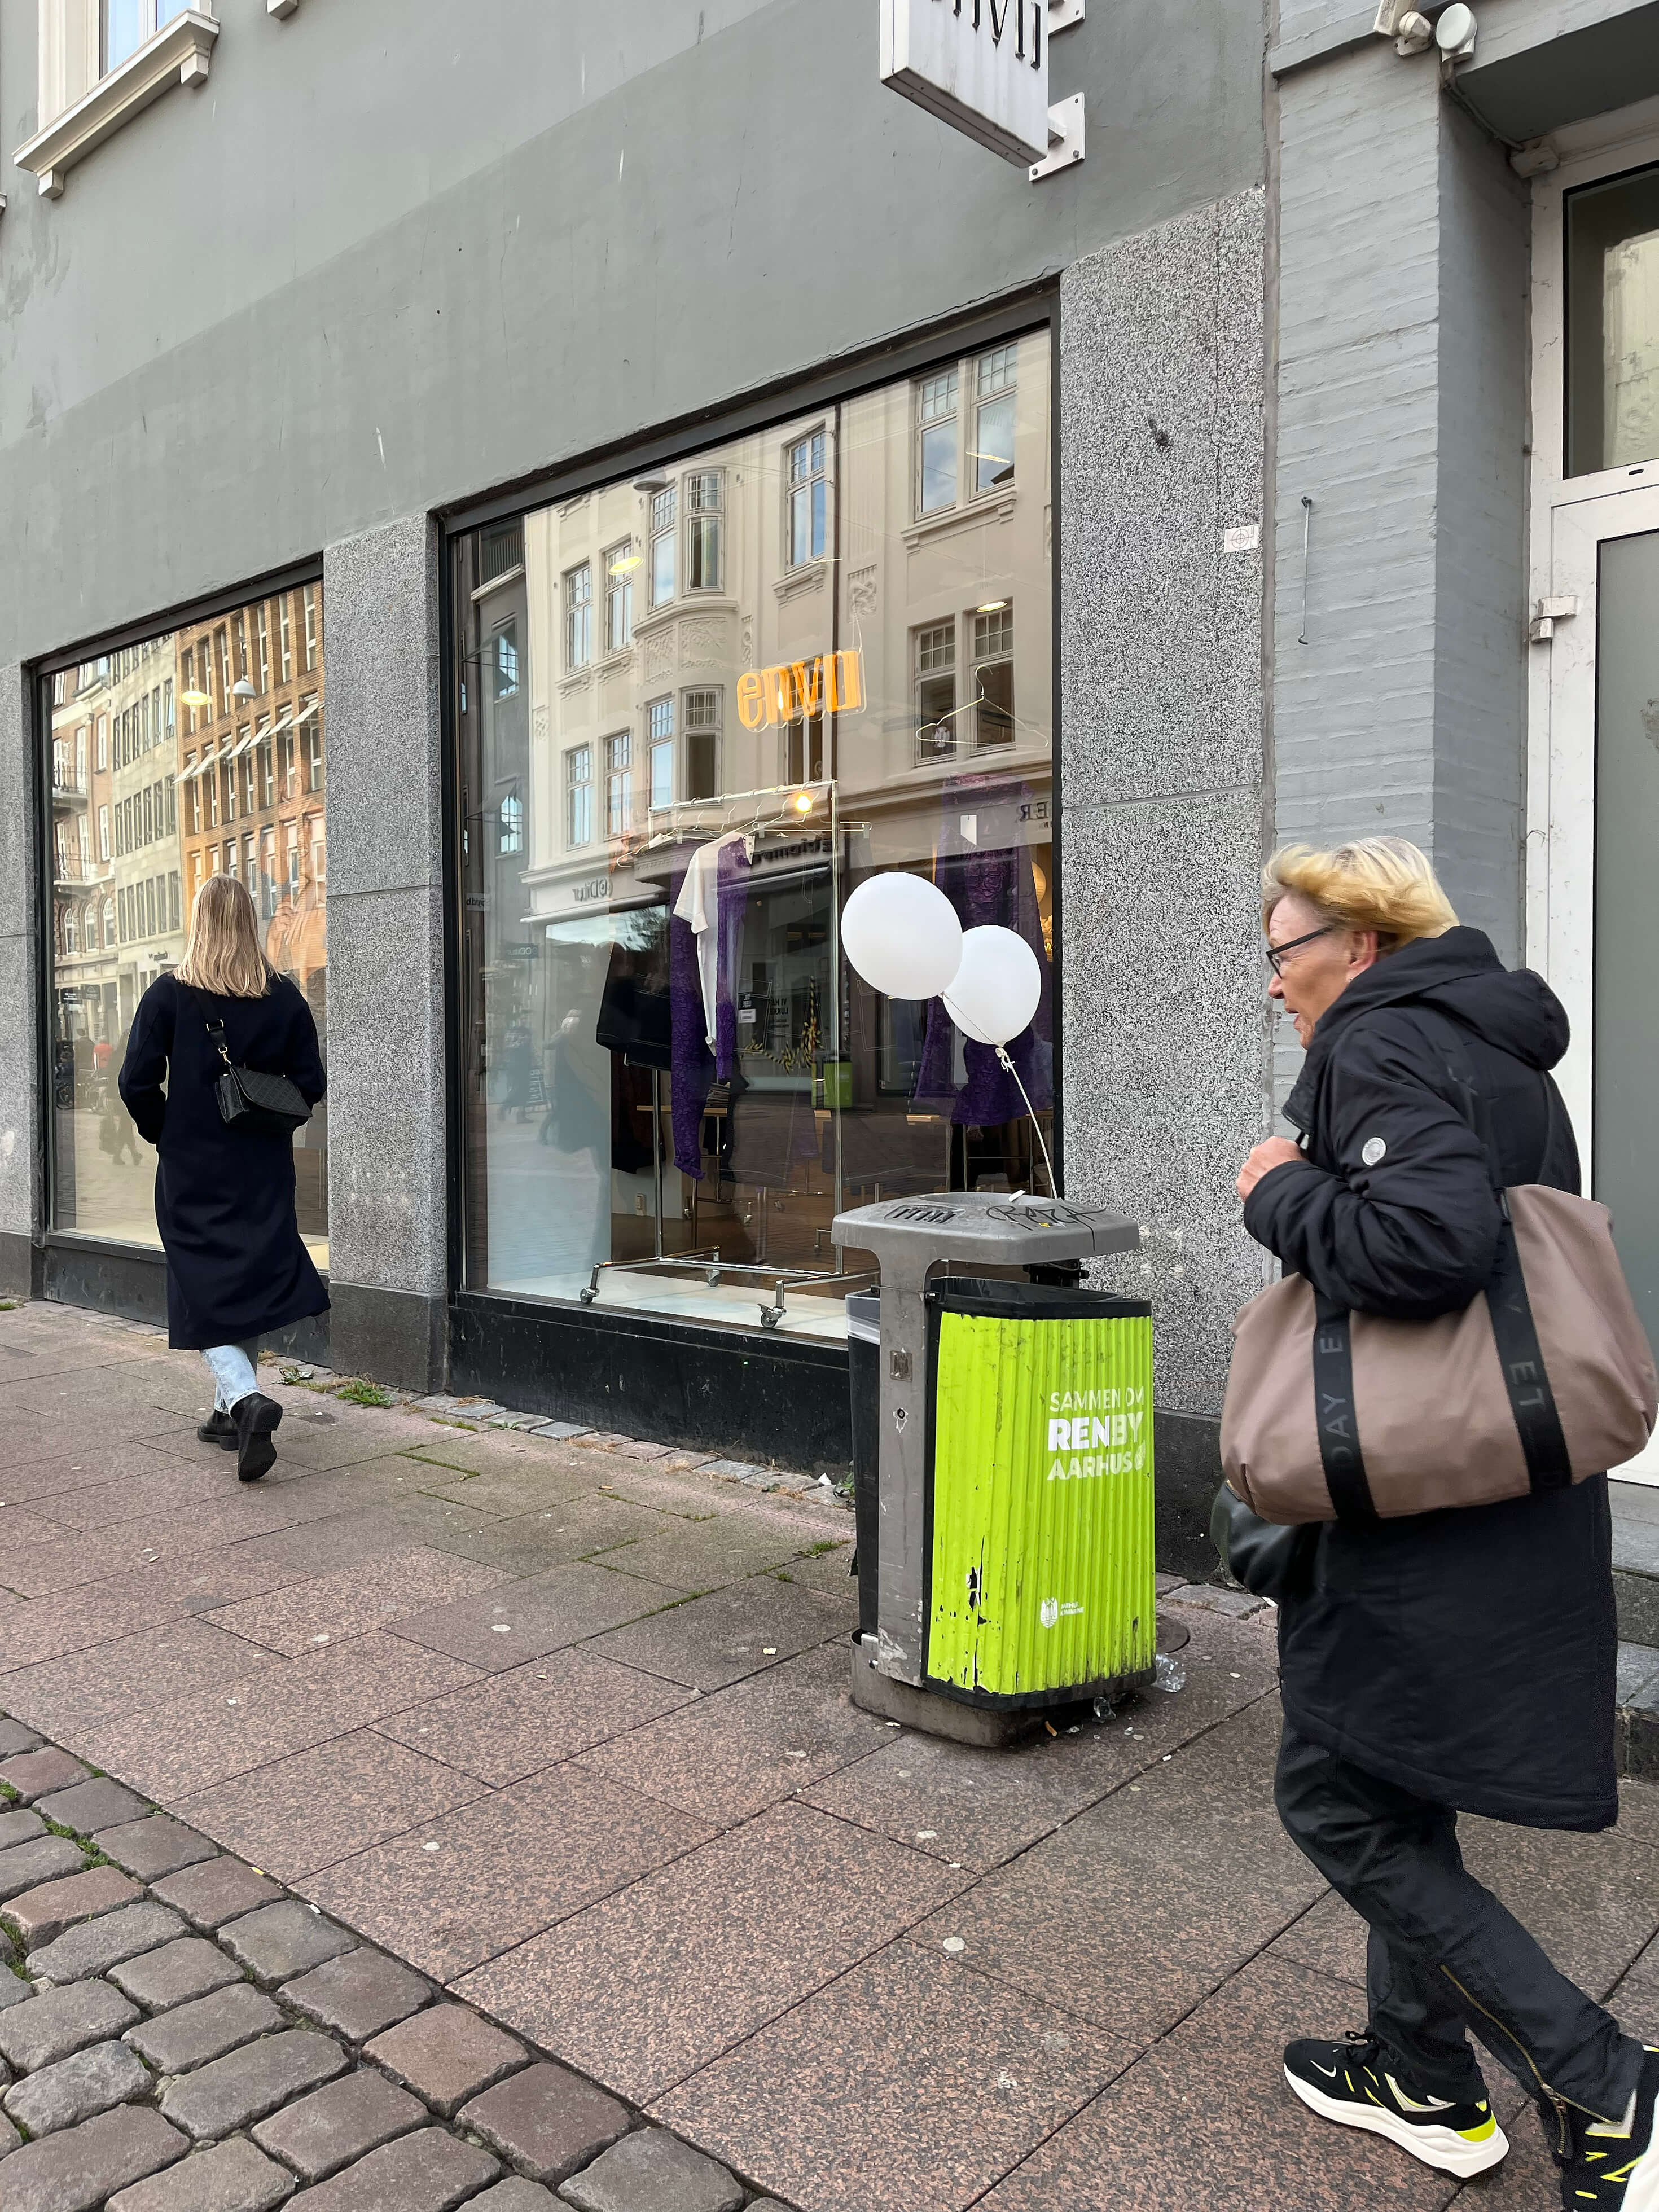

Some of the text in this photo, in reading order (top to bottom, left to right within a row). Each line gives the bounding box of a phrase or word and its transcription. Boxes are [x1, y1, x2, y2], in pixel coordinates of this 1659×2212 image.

[1050, 1386, 1144, 1412] SAMMEN OM
[1048, 1412, 1144, 1451] RENBY
[1047, 1451, 1133, 1481] AARHUS
